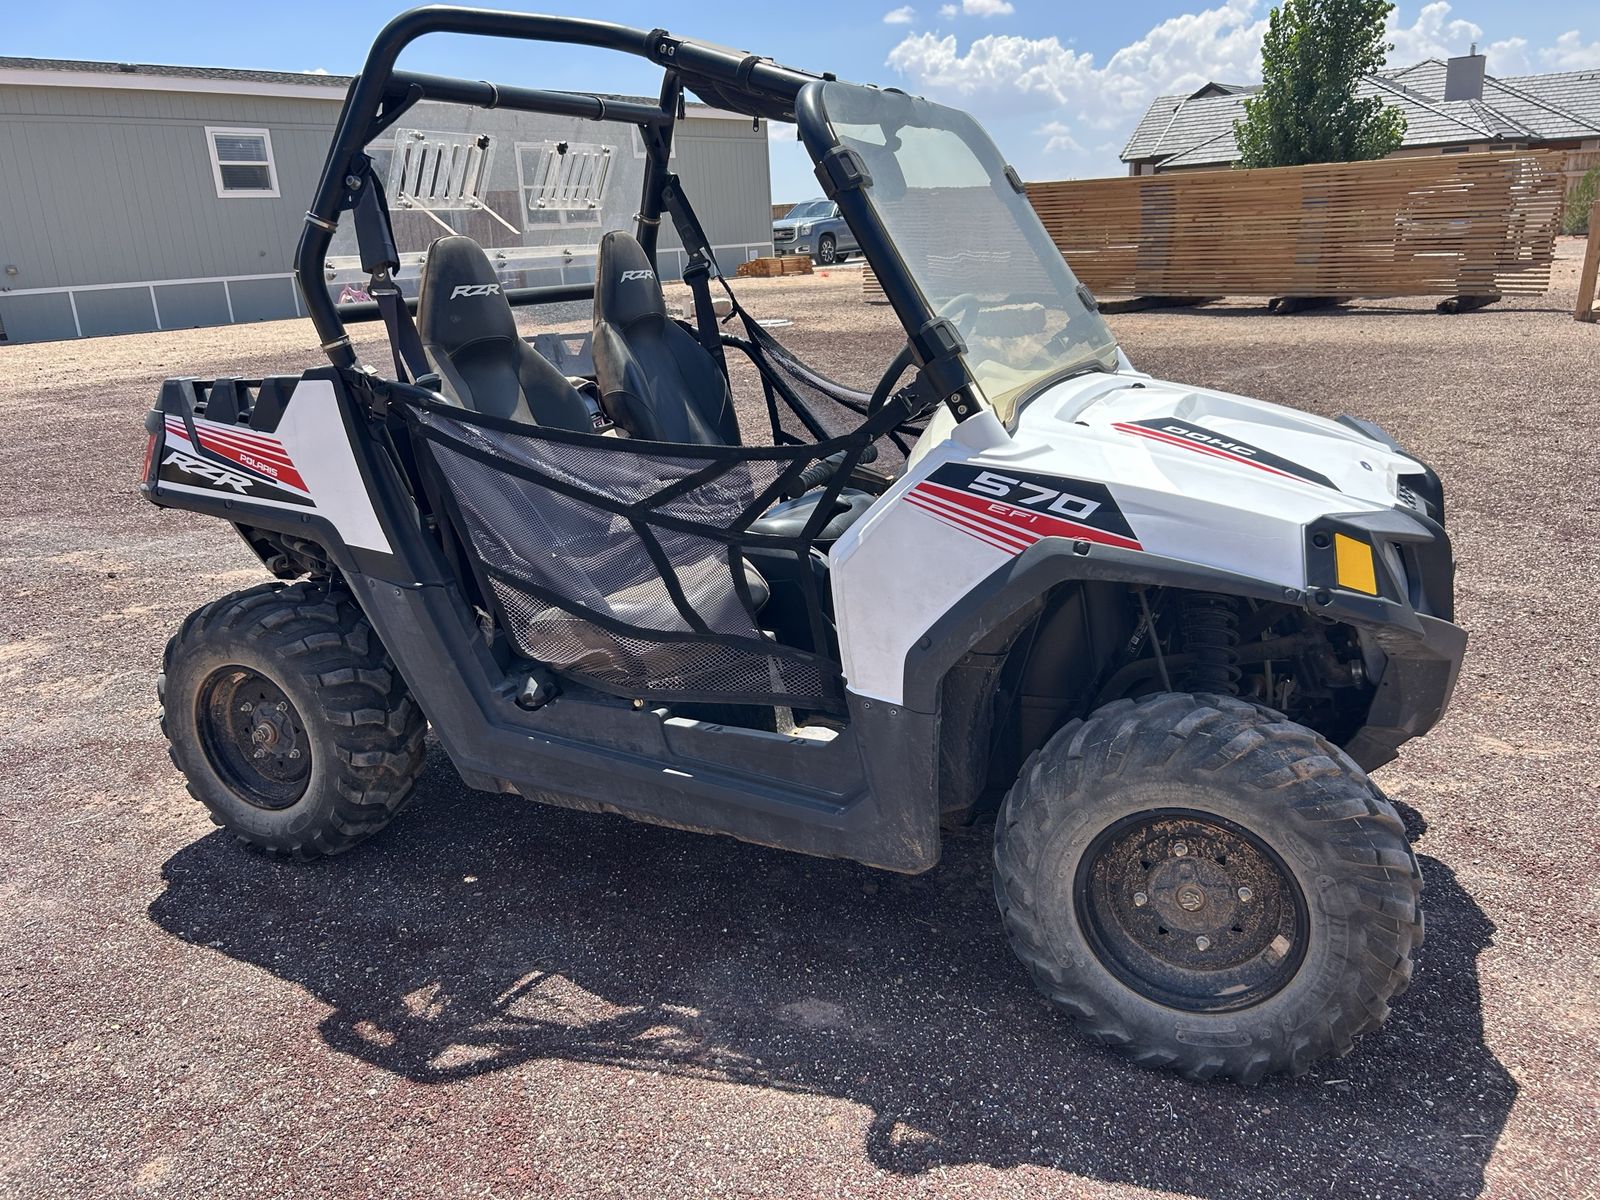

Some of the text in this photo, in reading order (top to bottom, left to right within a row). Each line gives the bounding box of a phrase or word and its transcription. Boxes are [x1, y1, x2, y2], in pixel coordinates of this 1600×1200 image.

[620, 269, 654, 284] RZR
[450, 283, 501, 300] RZR
[1161, 425, 1257, 456] DOHC
[162, 451, 254, 495] RZR
[239, 453, 279, 477] POLARIS
[967, 470, 1102, 520] 570
[986, 503, 1038, 523] EFI
